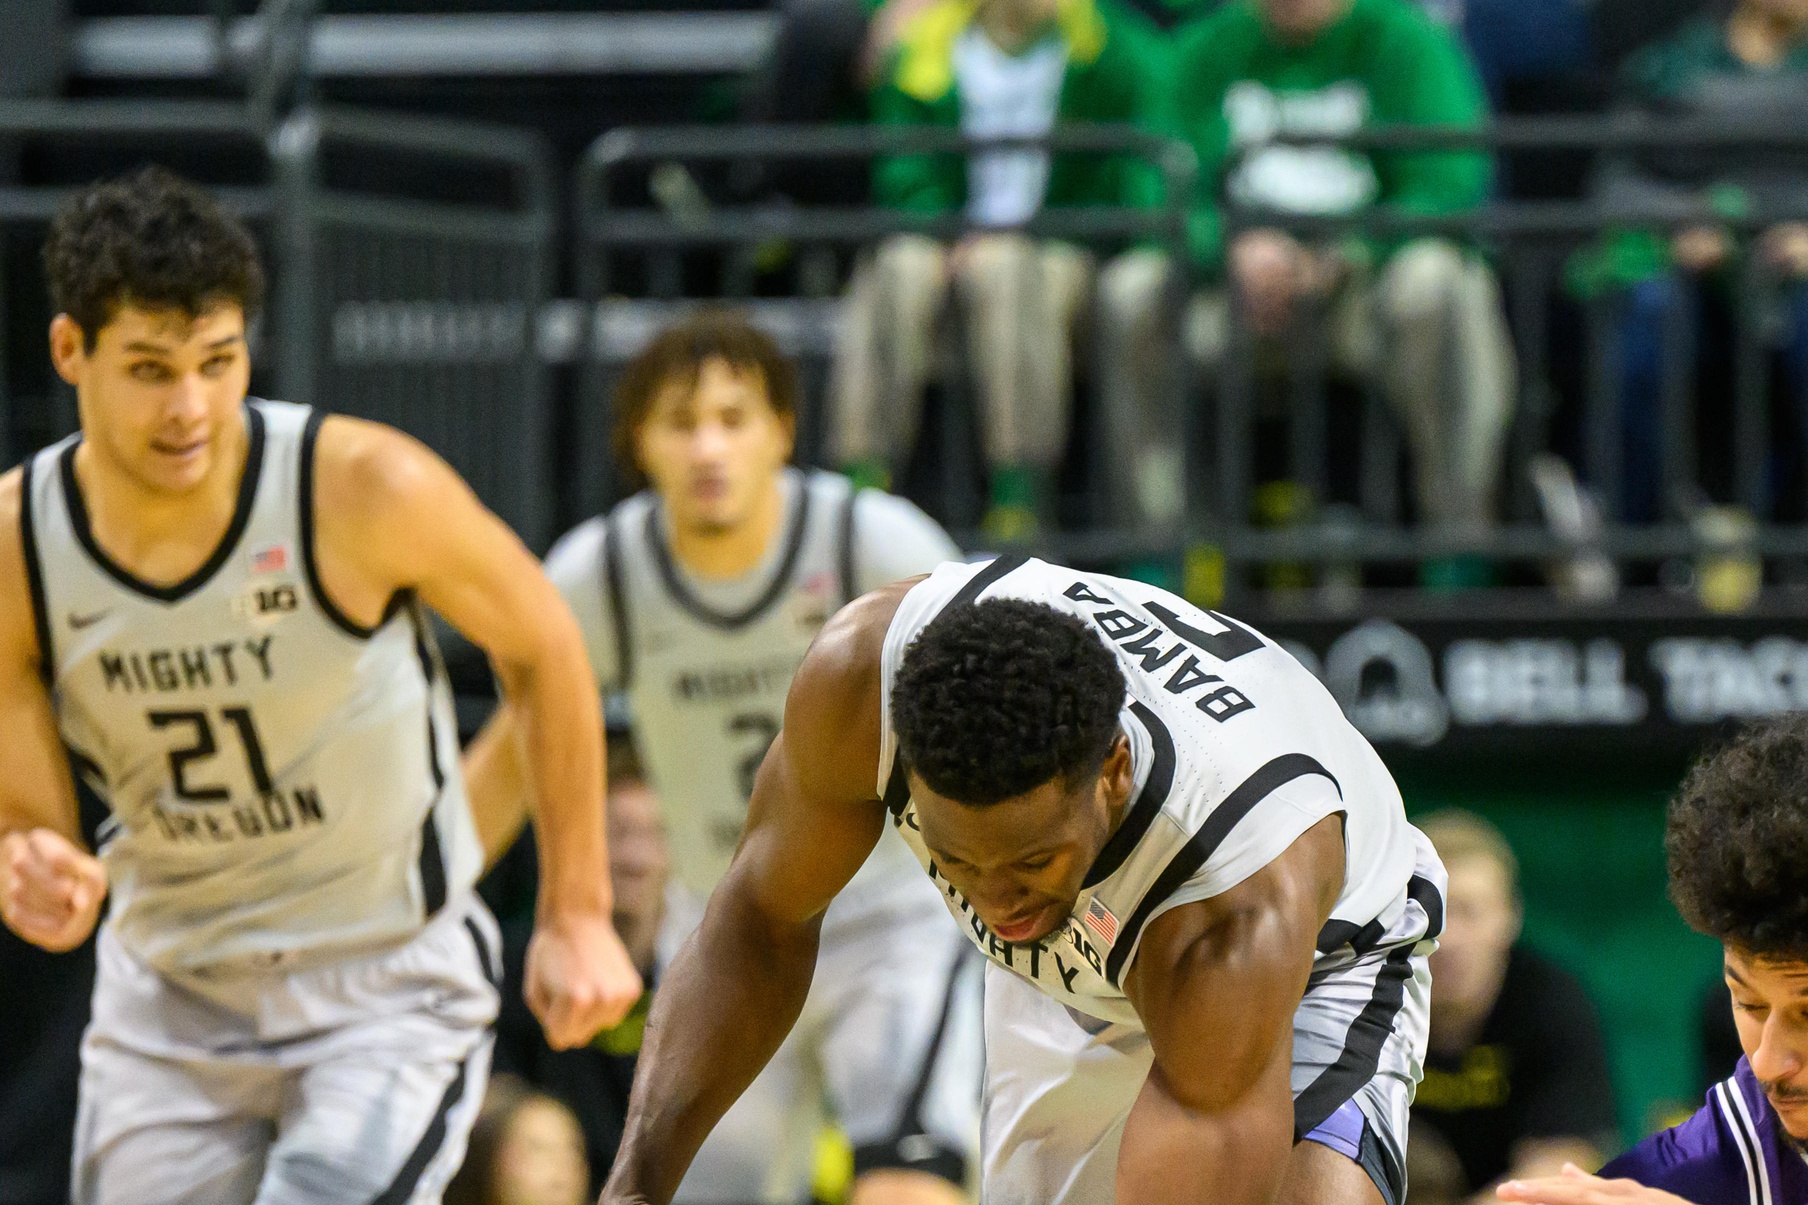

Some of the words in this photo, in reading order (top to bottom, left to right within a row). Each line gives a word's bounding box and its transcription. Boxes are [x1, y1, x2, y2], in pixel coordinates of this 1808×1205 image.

[99, 635, 273, 692] MIGHTY
[1063, 582, 1255, 723] BAMBA
[1443, 638, 1648, 724] BELL
[147, 705, 273, 803] 21
